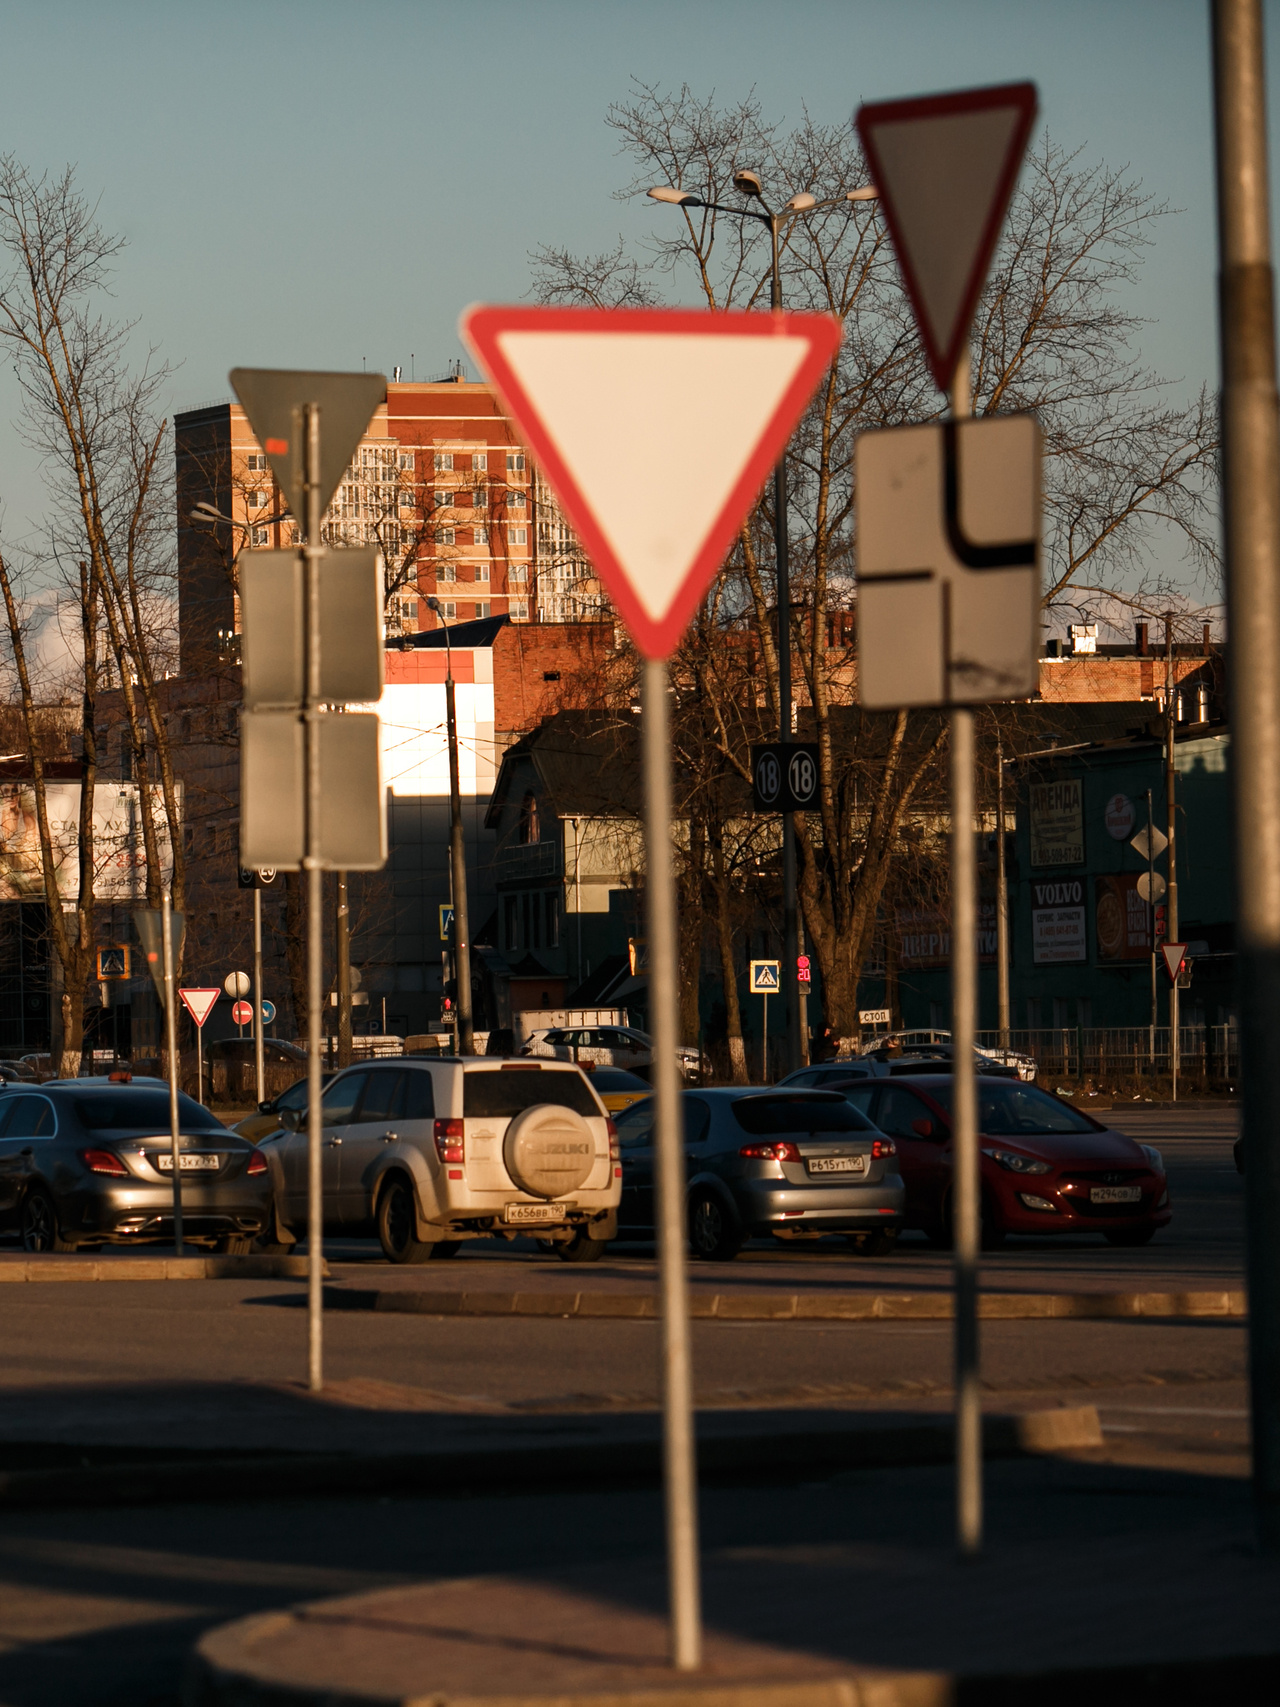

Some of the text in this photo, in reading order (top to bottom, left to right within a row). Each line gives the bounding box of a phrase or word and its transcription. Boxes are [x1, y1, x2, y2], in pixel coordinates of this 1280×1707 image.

[759, 760, 777, 794] 18
[792, 759, 813, 794] 18
[1032, 784, 1080, 813] АРЕНДА
[1034, 881, 1082, 905] VOLVO
[901, 933, 950, 957] ДВЕРИ
[797, 968, 810, 981] 20
[864, 1011, 887, 1022] СТОП
[527, 1143, 589, 1155] SUZUKI
[511, 1205, 564, 1218] К656ВВ 190
